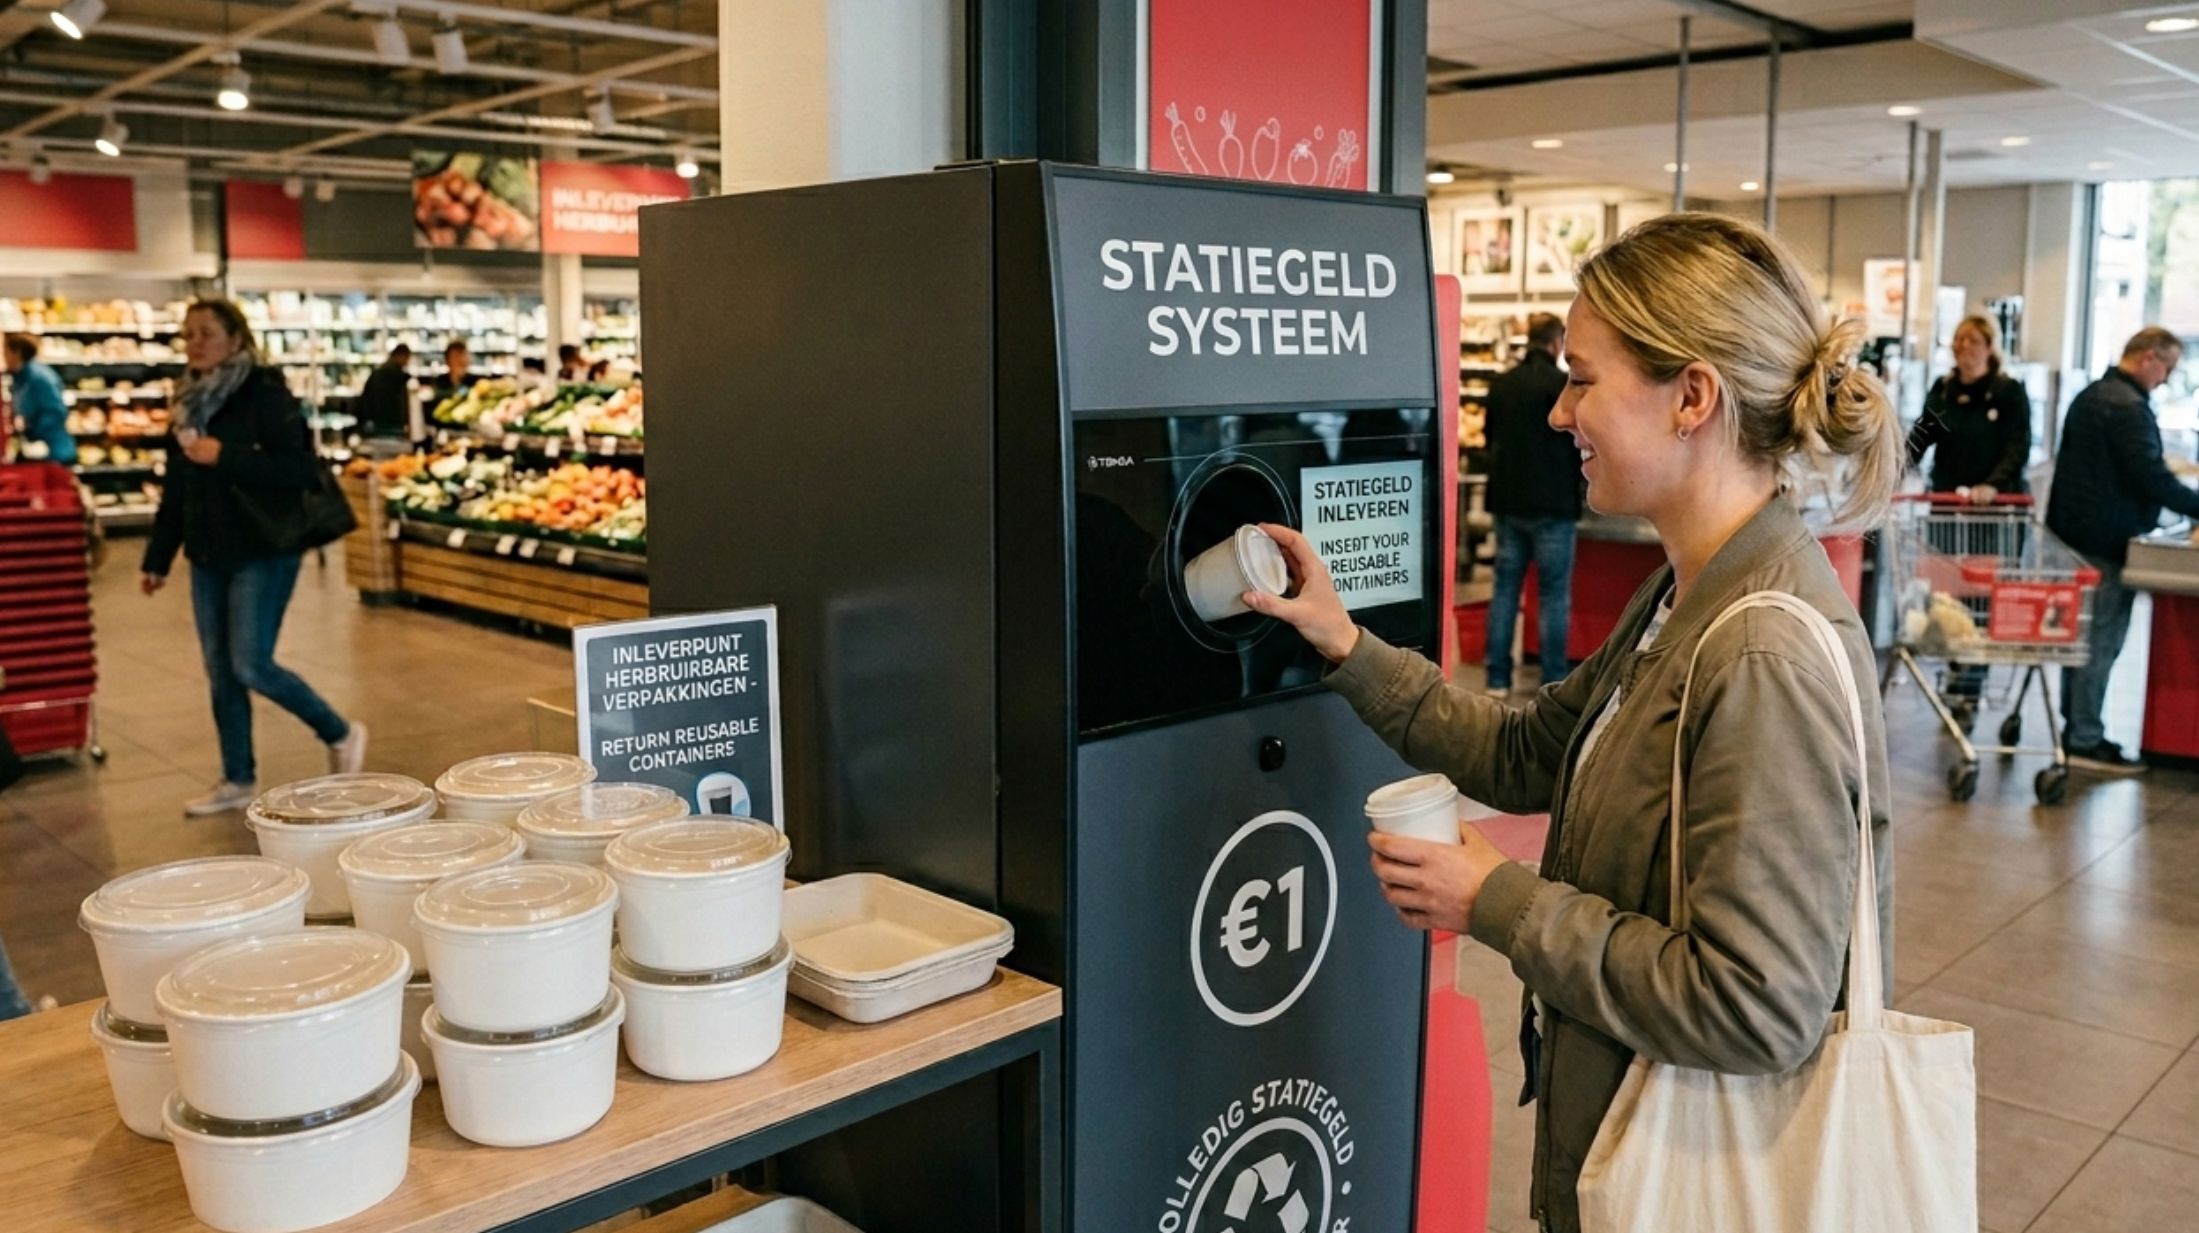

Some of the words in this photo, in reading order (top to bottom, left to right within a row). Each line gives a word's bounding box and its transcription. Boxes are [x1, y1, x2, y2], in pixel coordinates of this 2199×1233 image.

[1100, 238, 1397, 298] STATIEGELD
[1147, 305, 1368, 356] SYSTEEM
[1314, 475, 1413, 500] STATIEGELD
[1318, 499, 1409, 523] INLEVEREN
[1372, 531, 1409, 551] YOUR
[1331, 551, 1401, 574] REUSABLE
[1333, 569, 1409, 592] ONTAINERS
[612, 633, 743, 665] INLEVERPUNT
[605, 653, 750, 689] HERBRUIRBARE
[601, 730, 670, 757] RETURN
[674, 716, 760, 744] REUSABLE
[629, 740, 736, 773] CONTAINERS
[1220, 864, 1305, 969] €1
[1157, 1100, 1245, 1233] OLLEDIG
[1251, 1077, 1354, 1166] STATIEGELD
